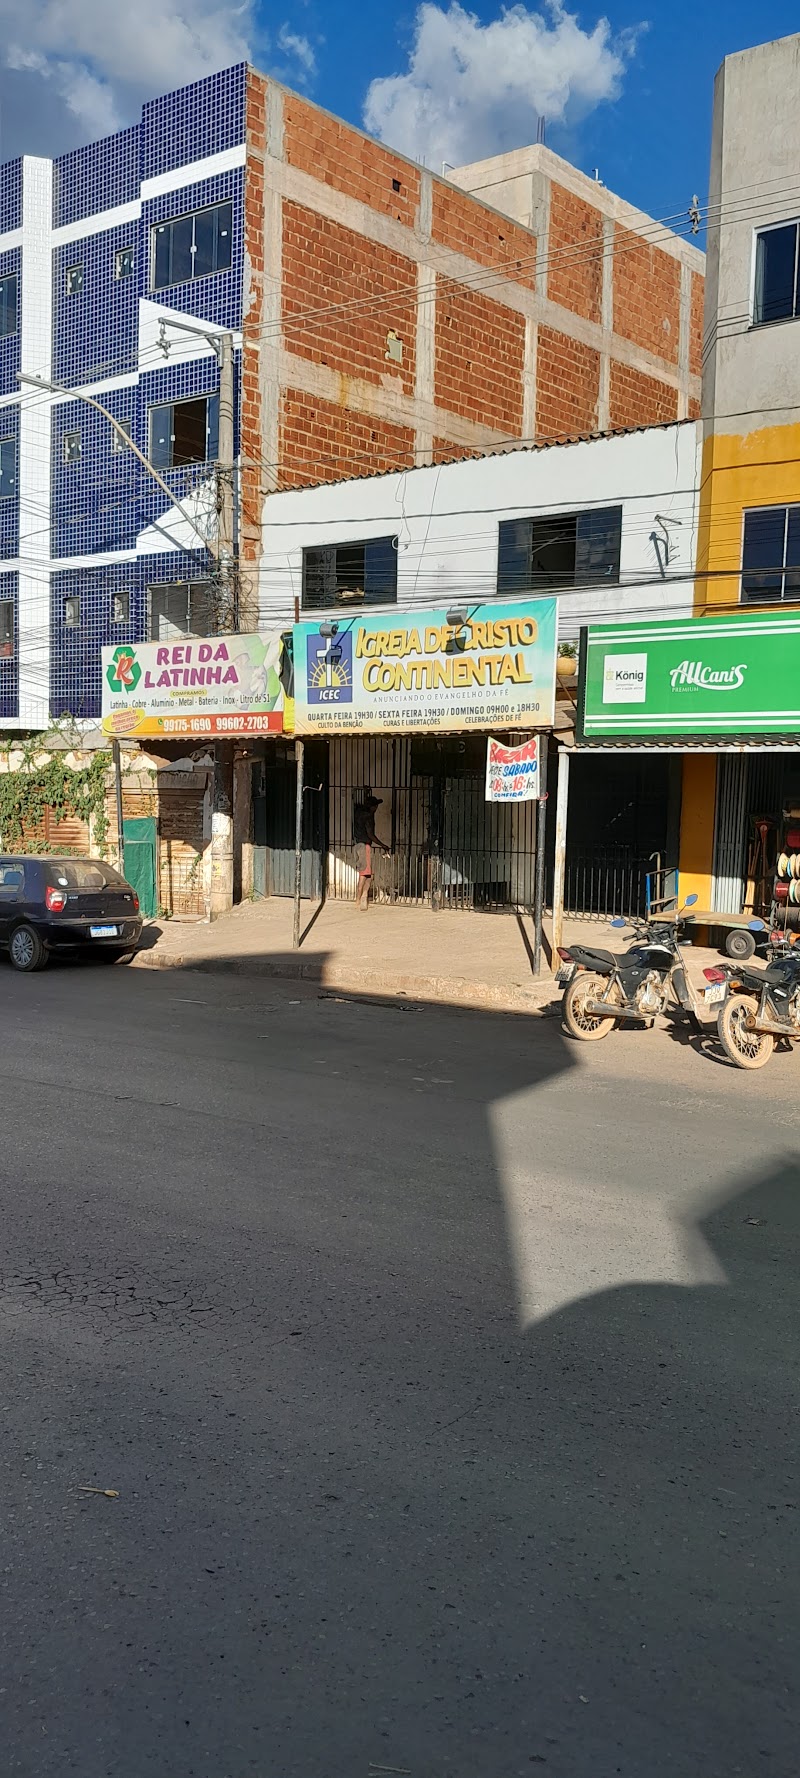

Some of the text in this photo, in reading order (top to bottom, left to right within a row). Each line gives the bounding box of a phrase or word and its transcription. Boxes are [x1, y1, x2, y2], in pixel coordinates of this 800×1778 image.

[355, 627, 422, 658] IGREJA
[456, 616, 539, 651] CRISTO
[156, 643, 229, 665] REI DA
[144, 665, 239, 689] LATINHA
[362, 652, 533, 692] CONTINENTAL
[615, 670, 644, 682] König
[110, 701, 128, 709] Latinha
[132, 699, 146, 708] Cobre
[179, 697, 194, 706] Metal
[198, 696, 218, 705] Bateria
[222, 695, 235, 704] Inox
[240, 694, 253, 704] Litro
[255, 694, 262, 703] de
[263, 694, 270, 703] 51
[319, 689, 340, 701] ICEC
[373, 694, 424, 703] ANUNCIANDO
[435, 691, 482, 700] EVANGELHO
[308, 712, 332, 721] QUARTA
[334, 712, 353, 720] FEIRA
[354, 711, 373, 720] 19H30
[379, 710, 400, 719] SEXTA
[402, 709, 422, 718] FEIRA
[424, 708, 445, 717] 19H30
[451, 706, 484, 715] DOMINGO
[487, 705, 509, 714] 09H00
[517, 703, 540, 712] 18H30
[465, 715, 504, 724] CELEBRAÇÕES
[515, 713, 522, 721] FÉ
[163, 716, 269, 732] 99175-1690 99602-2703
[318, 721, 333, 729] CULTO
[342, 720, 363, 729] BENÇÃO
[405, 718, 440, 727] LIBERTAÇÕES
[502, 760, 537, 777] SABADO
